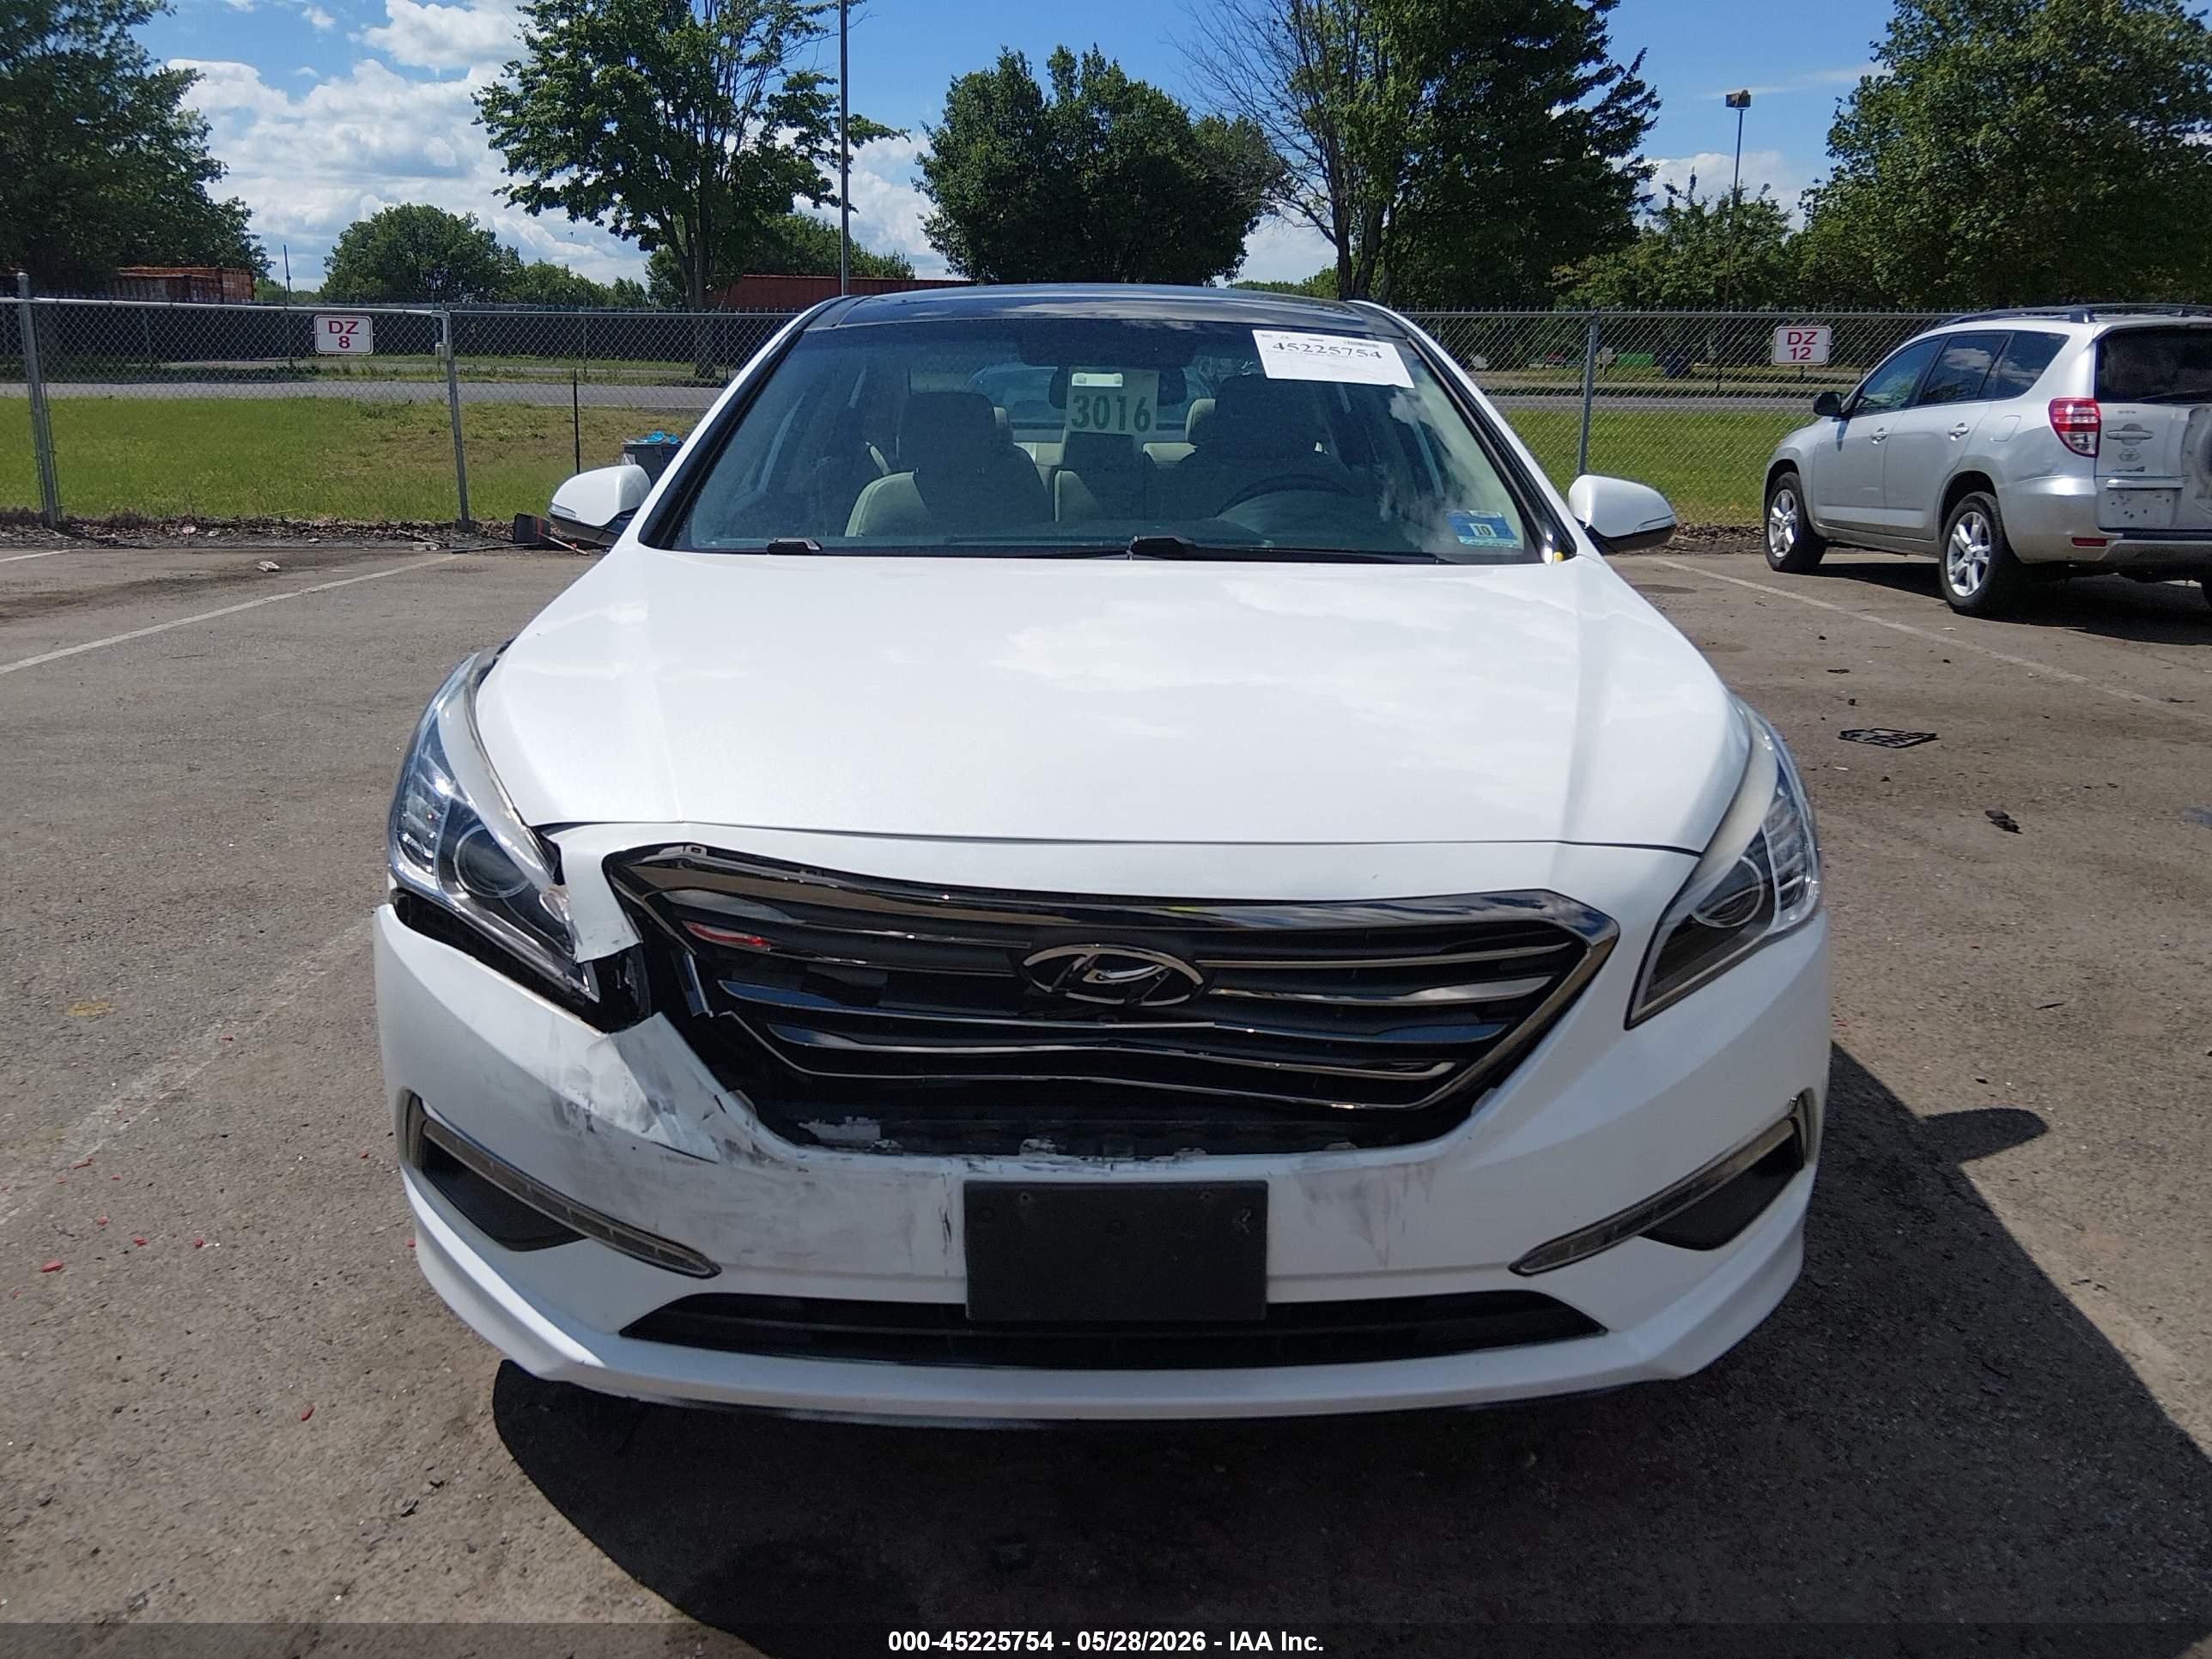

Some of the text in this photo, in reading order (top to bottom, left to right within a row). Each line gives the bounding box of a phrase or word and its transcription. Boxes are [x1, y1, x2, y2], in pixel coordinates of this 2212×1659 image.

[328, 320, 359, 335] DZ
[338, 336, 350, 349] 8
[1787, 331, 1818, 345] DZ
[1273, 342, 1382, 360] 45225754
[1789, 346, 1811, 361] 12
[1071, 395, 1151, 433] 3016
